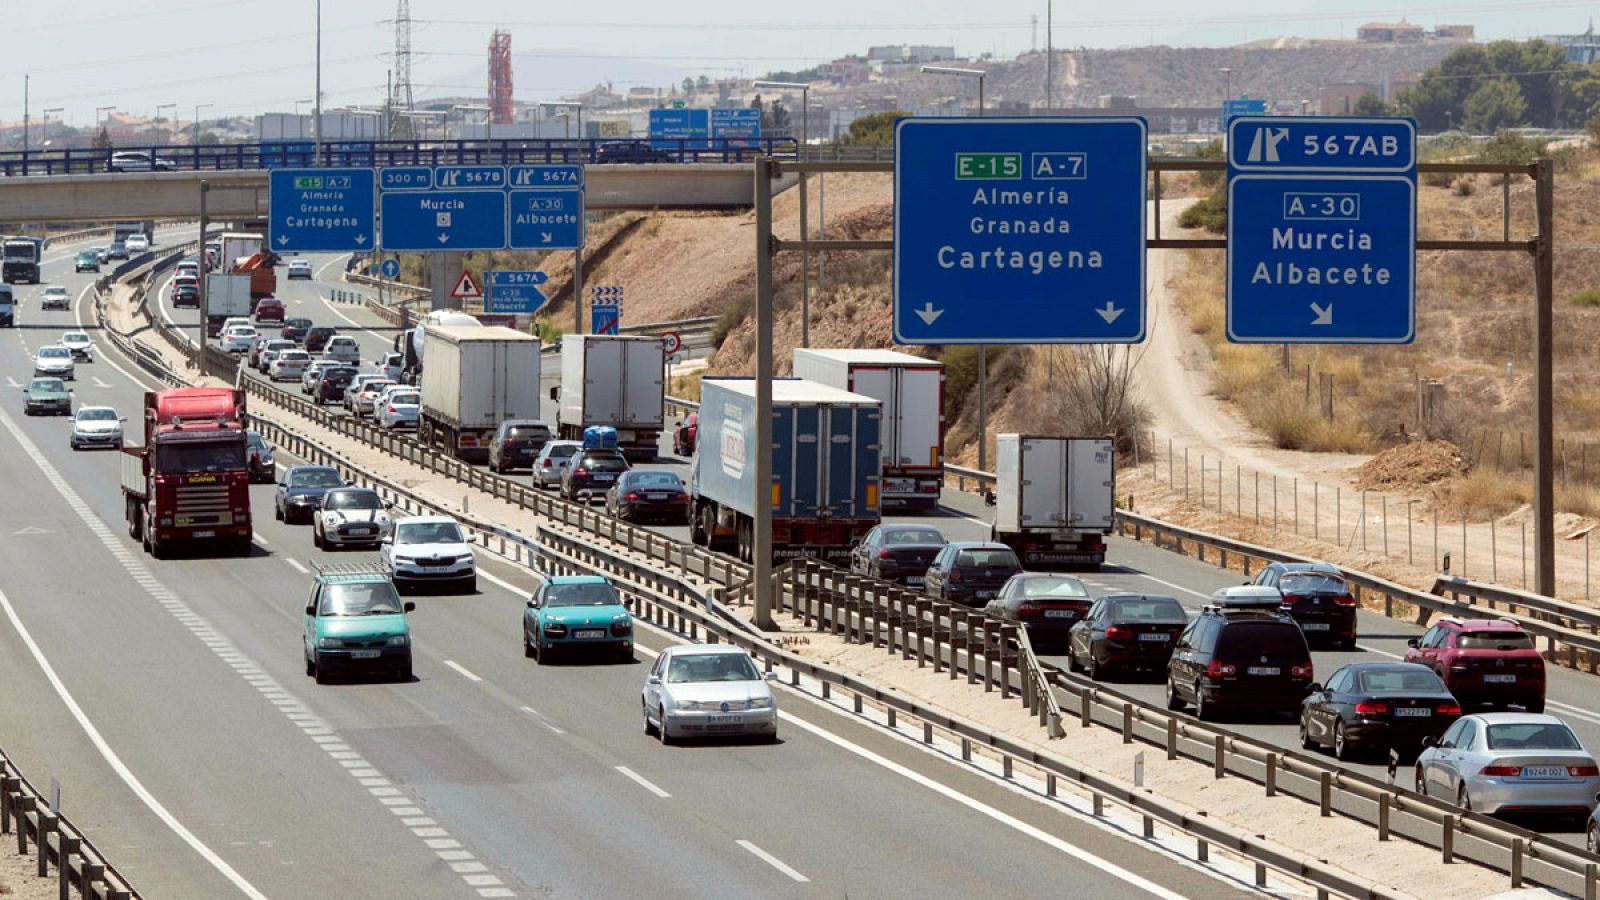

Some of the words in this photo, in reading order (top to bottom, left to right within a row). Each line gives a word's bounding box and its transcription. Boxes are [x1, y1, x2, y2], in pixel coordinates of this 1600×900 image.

[1303, 135, 1398, 156] 567AB
[959, 157, 1018, 176] E-15
[1036, 157, 1083, 176] A-7
[387, 174, 411, 183] 300
[416, 175, 426, 183] m
[466, 171, 500, 182] 567B
[543, 171, 577, 181] 567A
[294, 177, 321, 188] E-15
[328, 177, 349, 187] A-7
[971, 187, 1069, 205] Almería
[300, 204, 344, 212] Granada
[420, 199, 465, 209] Murcia
[531, 200, 561, 209] A-30
[1288, 197, 1356, 216] A-30
[286, 216, 358, 229] Cartagena
[515, 213, 577, 225] Albacete
[970, 216, 1070, 234] Granada
[1272, 227, 1372, 250] Murcia
[937, 245, 1103, 274] Cartagena
[508, 273, 538, 283] 567A
[1251, 262, 1391, 285] Albacete
[188, 475, 217, 484] SCANIA
